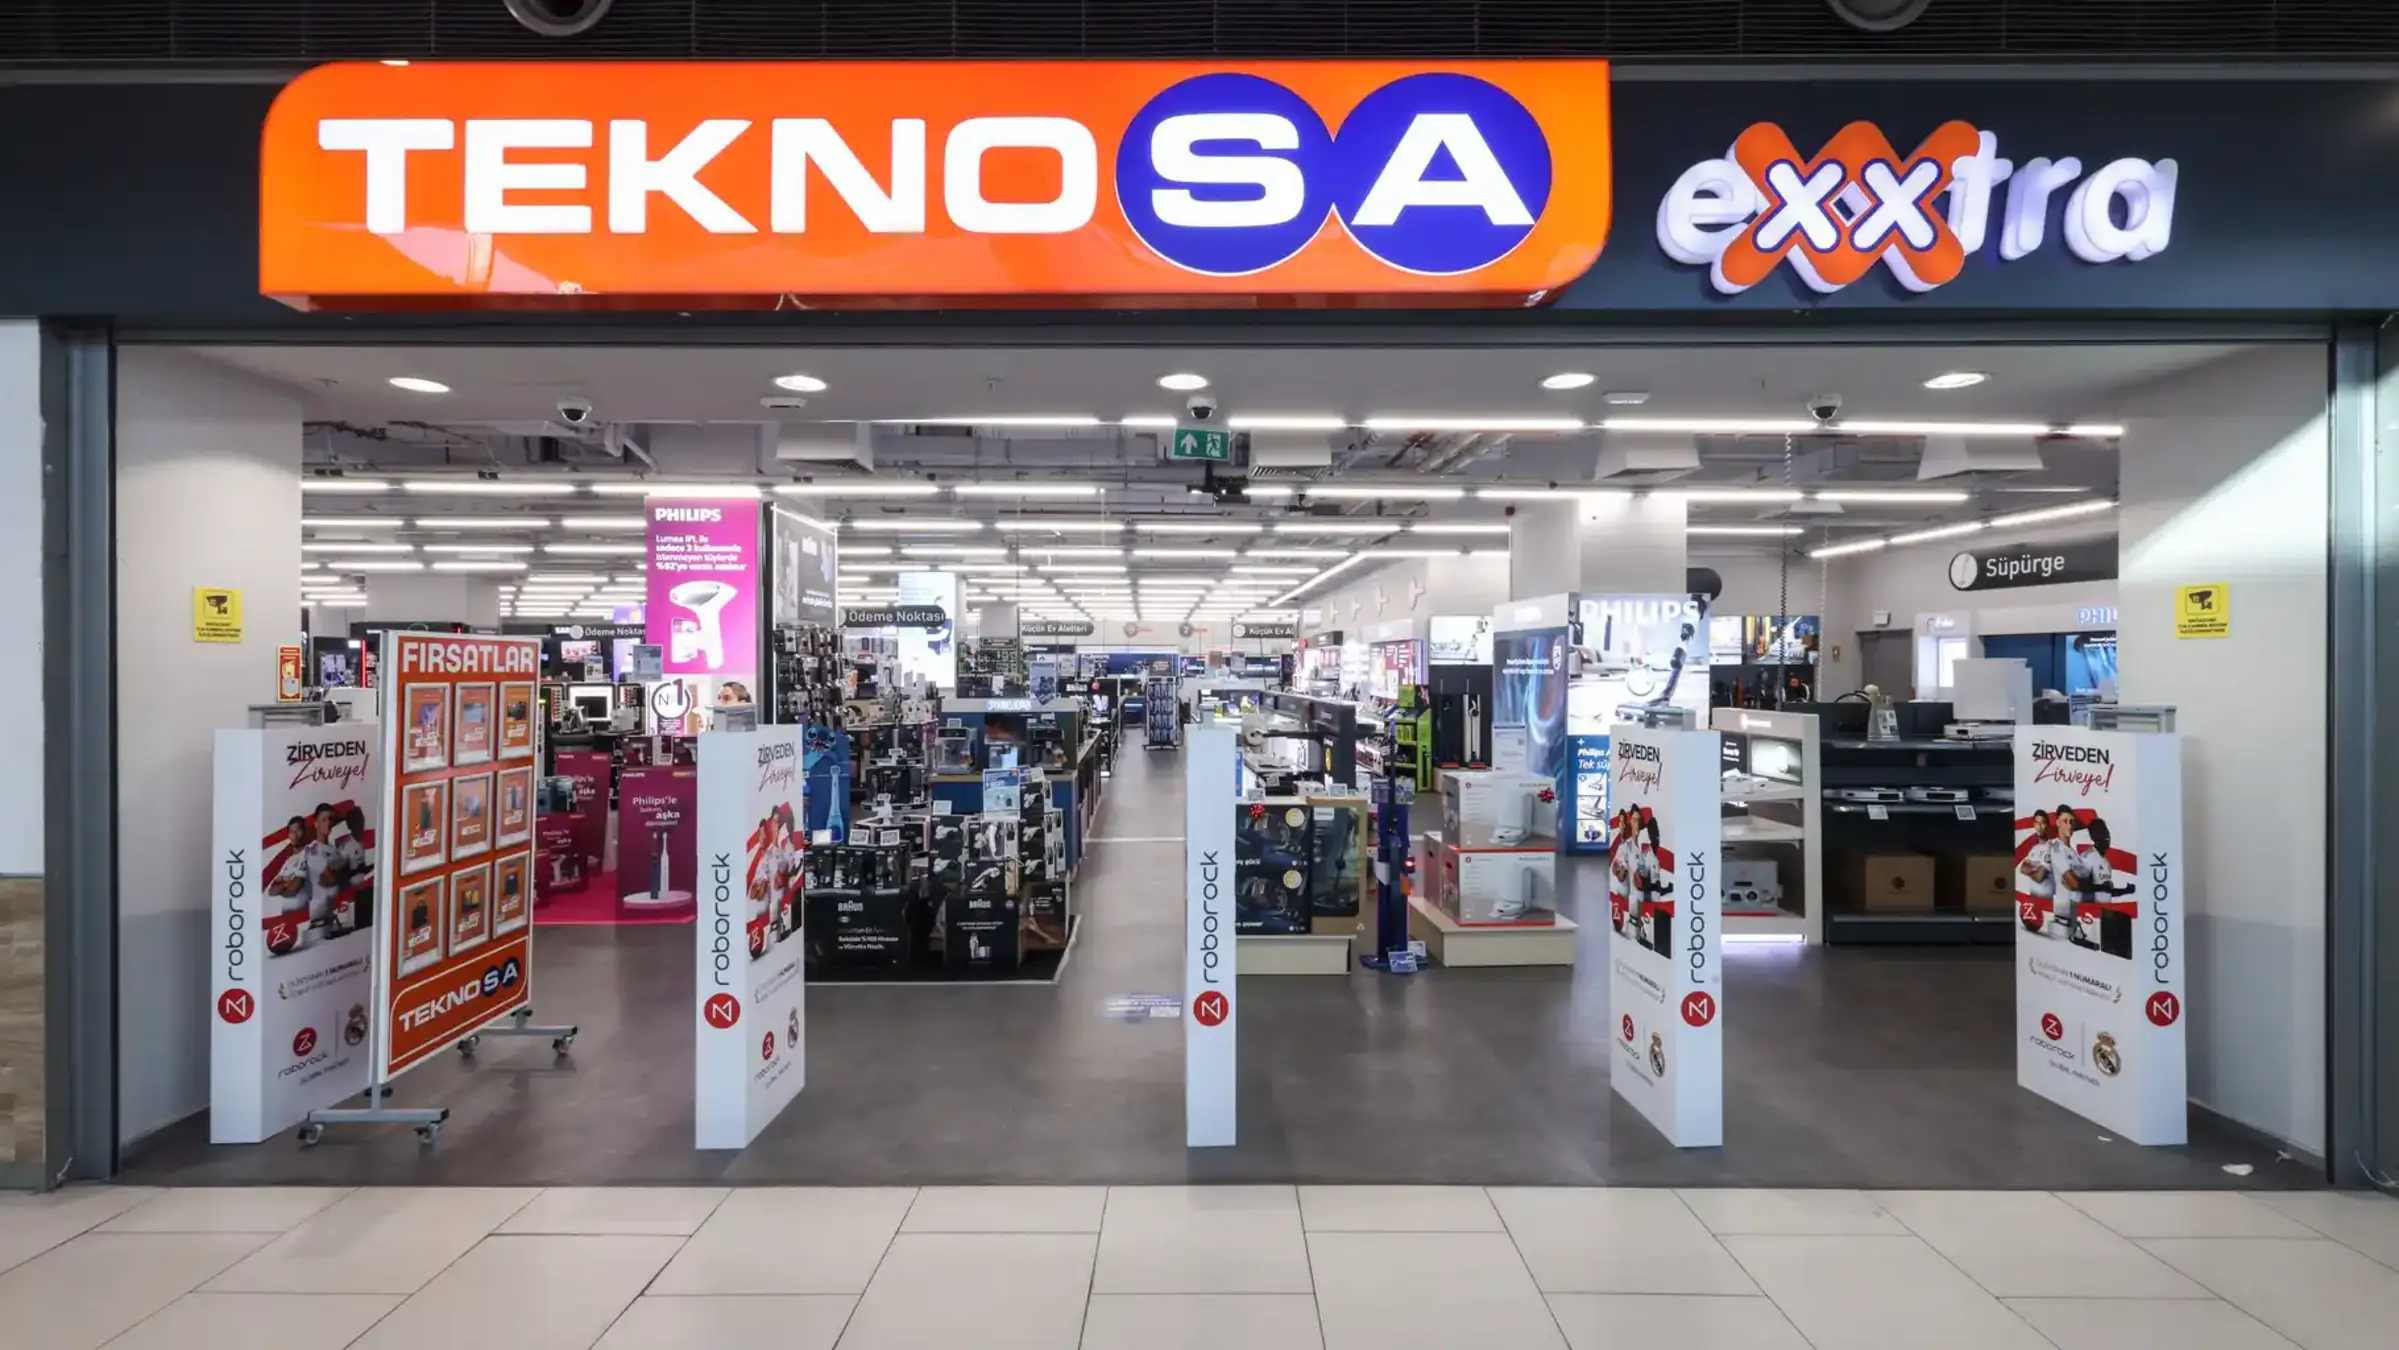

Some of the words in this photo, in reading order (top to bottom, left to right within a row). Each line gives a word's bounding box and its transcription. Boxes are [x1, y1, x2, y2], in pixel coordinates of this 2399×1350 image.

[318, 112, 1536, 235] TEKNOSA
[1656, 120, 2178, 293] exxtra
[654, 508, 722, 522] PHILIPS
[1985, 555, 2066, 580] Süpürge
[849, 610, 893, 622] Ödeme
[1580, 599, 1699, 624] PHILIPS
[585, 627, 615, 636] Ödeme
[402, 642, 534, 673] FIRSATLAR
[1578, 759, 1594, 769] Tek
[2033, 755, 2115, 796] Zirveye!
[632, 795, 678, 807] Philips'le
[655, 810, 680, 821] aşka
[226, 848, 245, 983] roborock
[712, 851, 731, 986] roborock
[838, 900, 864, 912] BRAUN
[1200, 850, 1219, 984] roborock
[1687, 851, 1705, 984] roborock
[2150, 851, 2168, 984] roborock
[398, 962, 520, 1033] TEKNOSA
